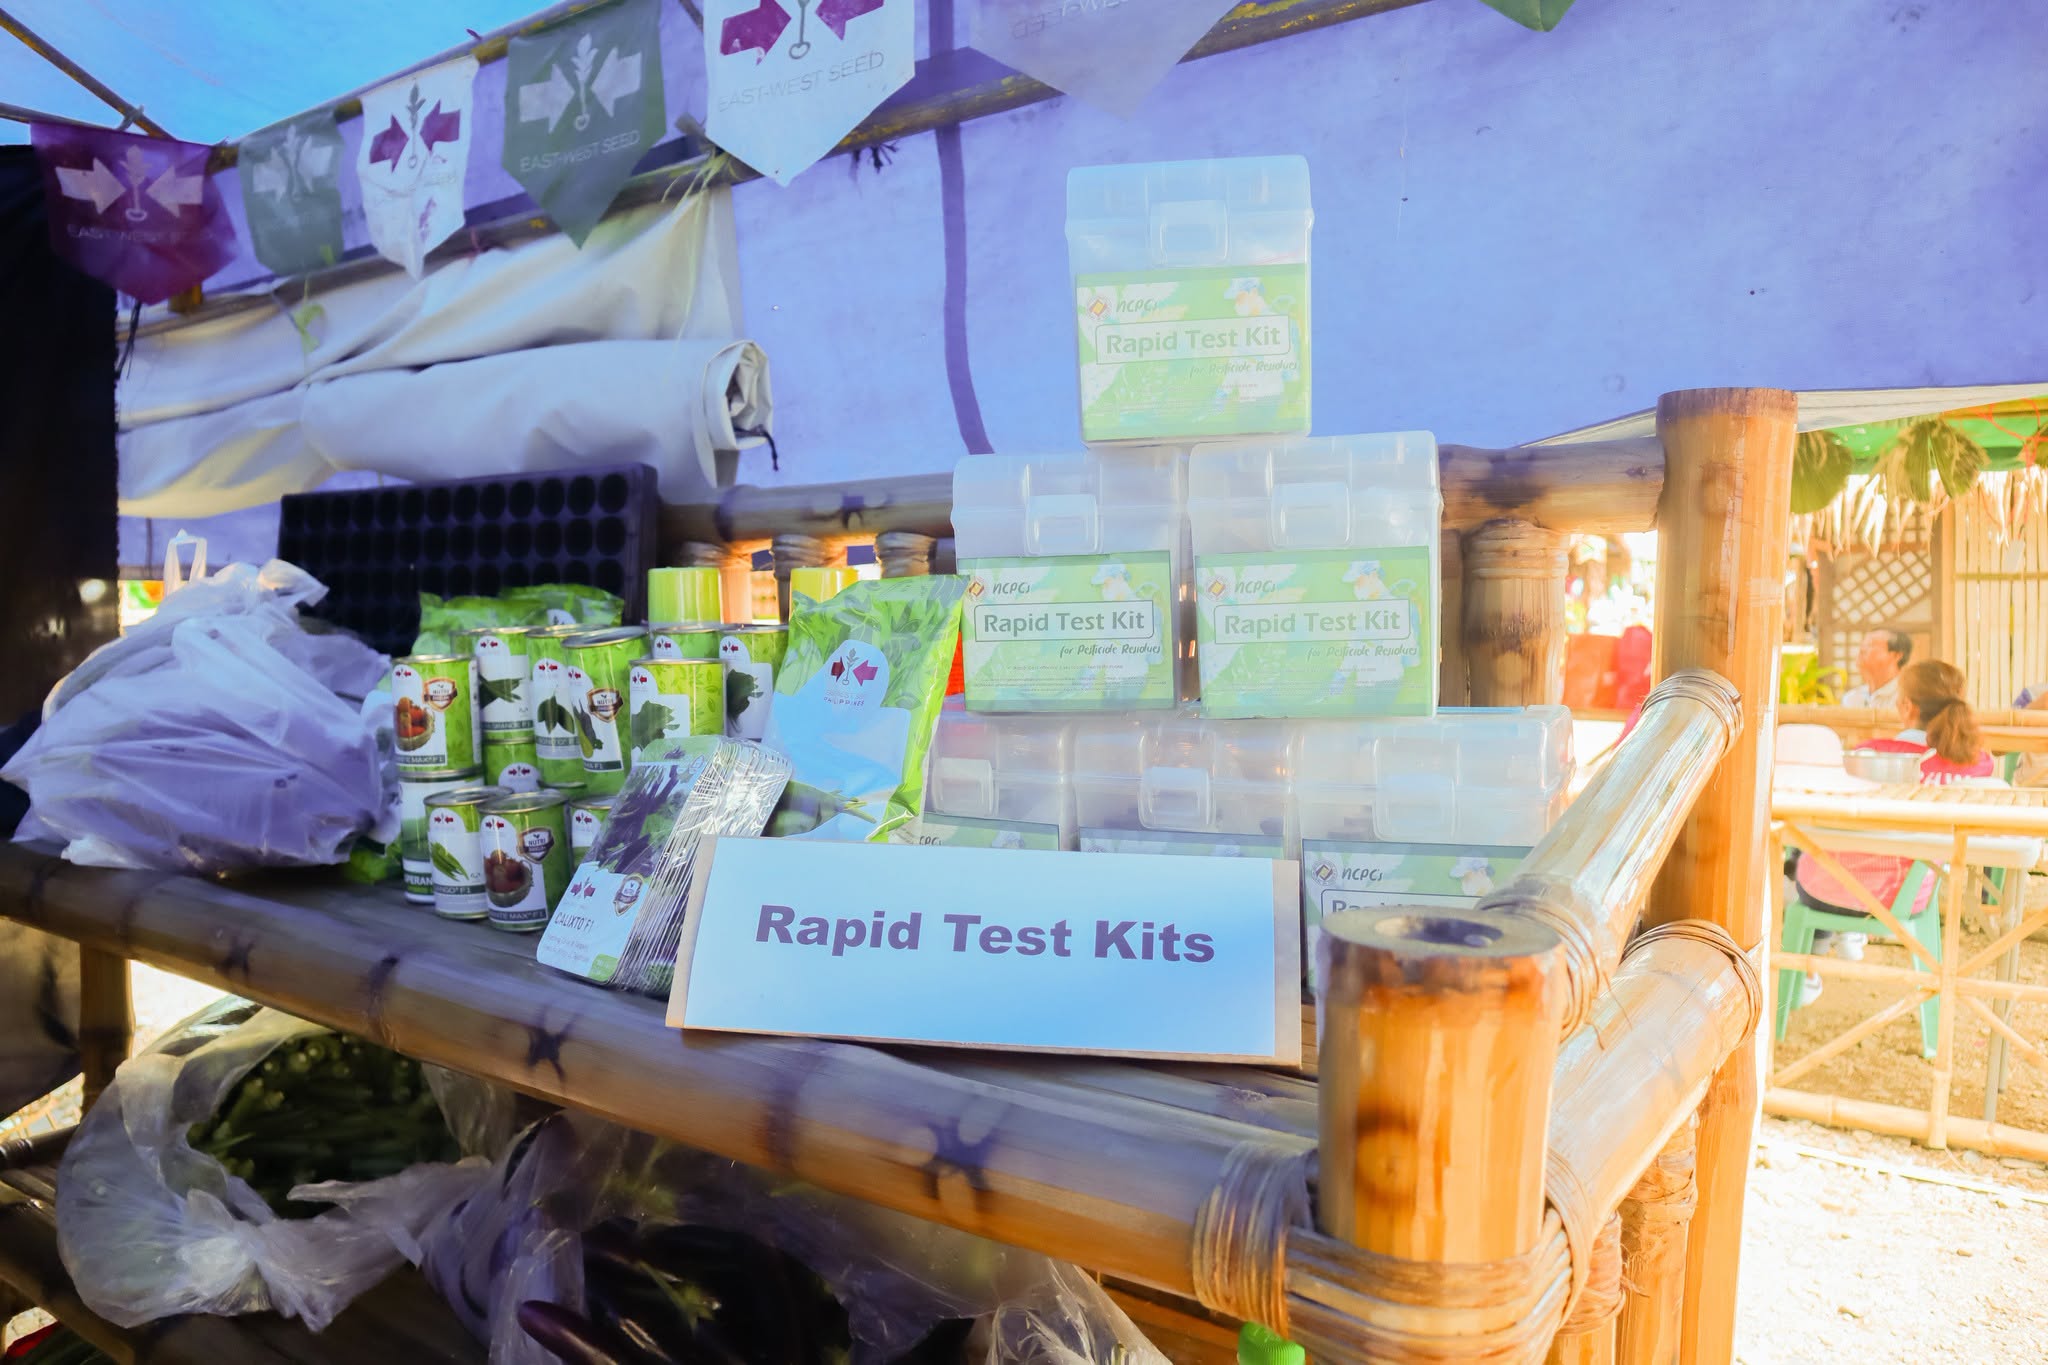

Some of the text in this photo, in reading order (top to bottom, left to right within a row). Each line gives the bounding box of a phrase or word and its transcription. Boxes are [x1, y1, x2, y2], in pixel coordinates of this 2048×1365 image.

[718, 51, 885, 112] EAST-WEST SEED
[520, 130, 641, 172] EAST-WEST SEED
[1106, 326, 1281, 359] Rapid Test Kit
[983, 610, 1145, 638] Rapid Test Kit
[1224, 609, 1401, 639] Rapid Test Kit
[1059, 643, 1161, 658] for Pesticide Residues
[1374, 644, 1418, 657] Residues
[554, 911, 585, 931] CALIXTO
[755, 904, 1216, 963] Rapid Test Kits
